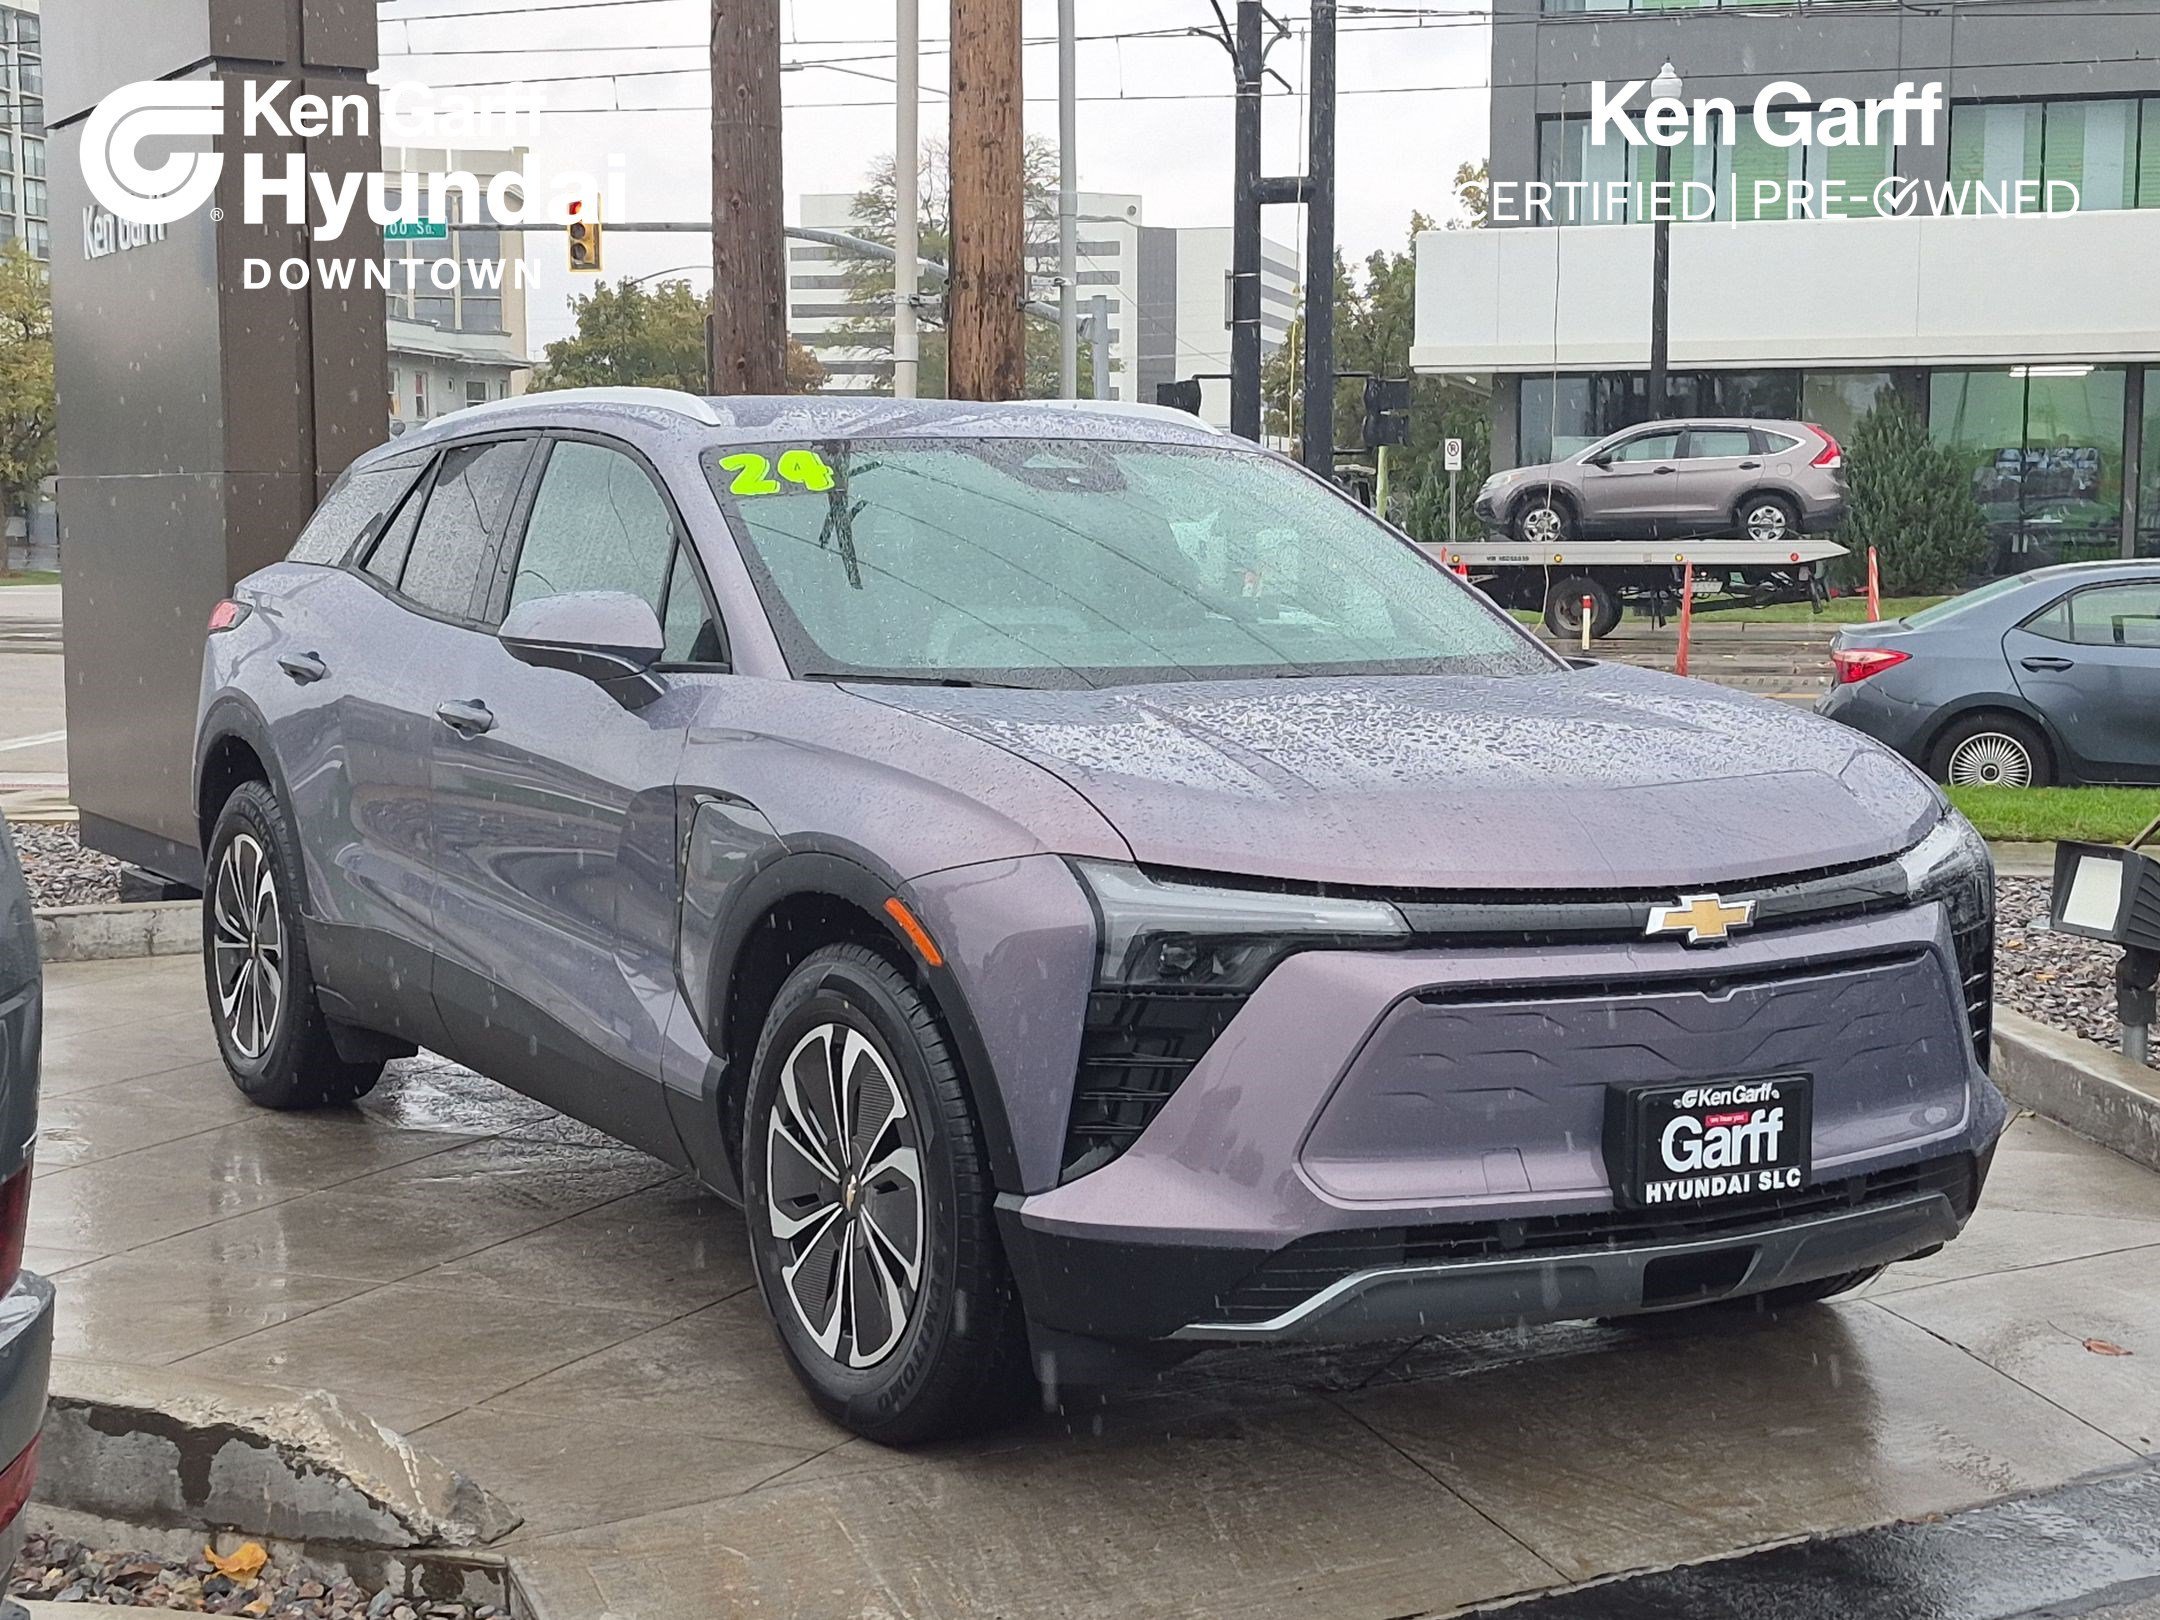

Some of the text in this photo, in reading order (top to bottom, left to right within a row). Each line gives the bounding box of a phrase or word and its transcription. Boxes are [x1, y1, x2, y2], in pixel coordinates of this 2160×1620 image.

[82, 204, 117, 261] Ken
[719, 450, 835, 495] 24
[1698, 1082, 1773, 1107] Ken Garff
[1661, 1107, 1784, 1173] Garff
[1645, 1167, 1801, 1204] HYUNDAI SLC
